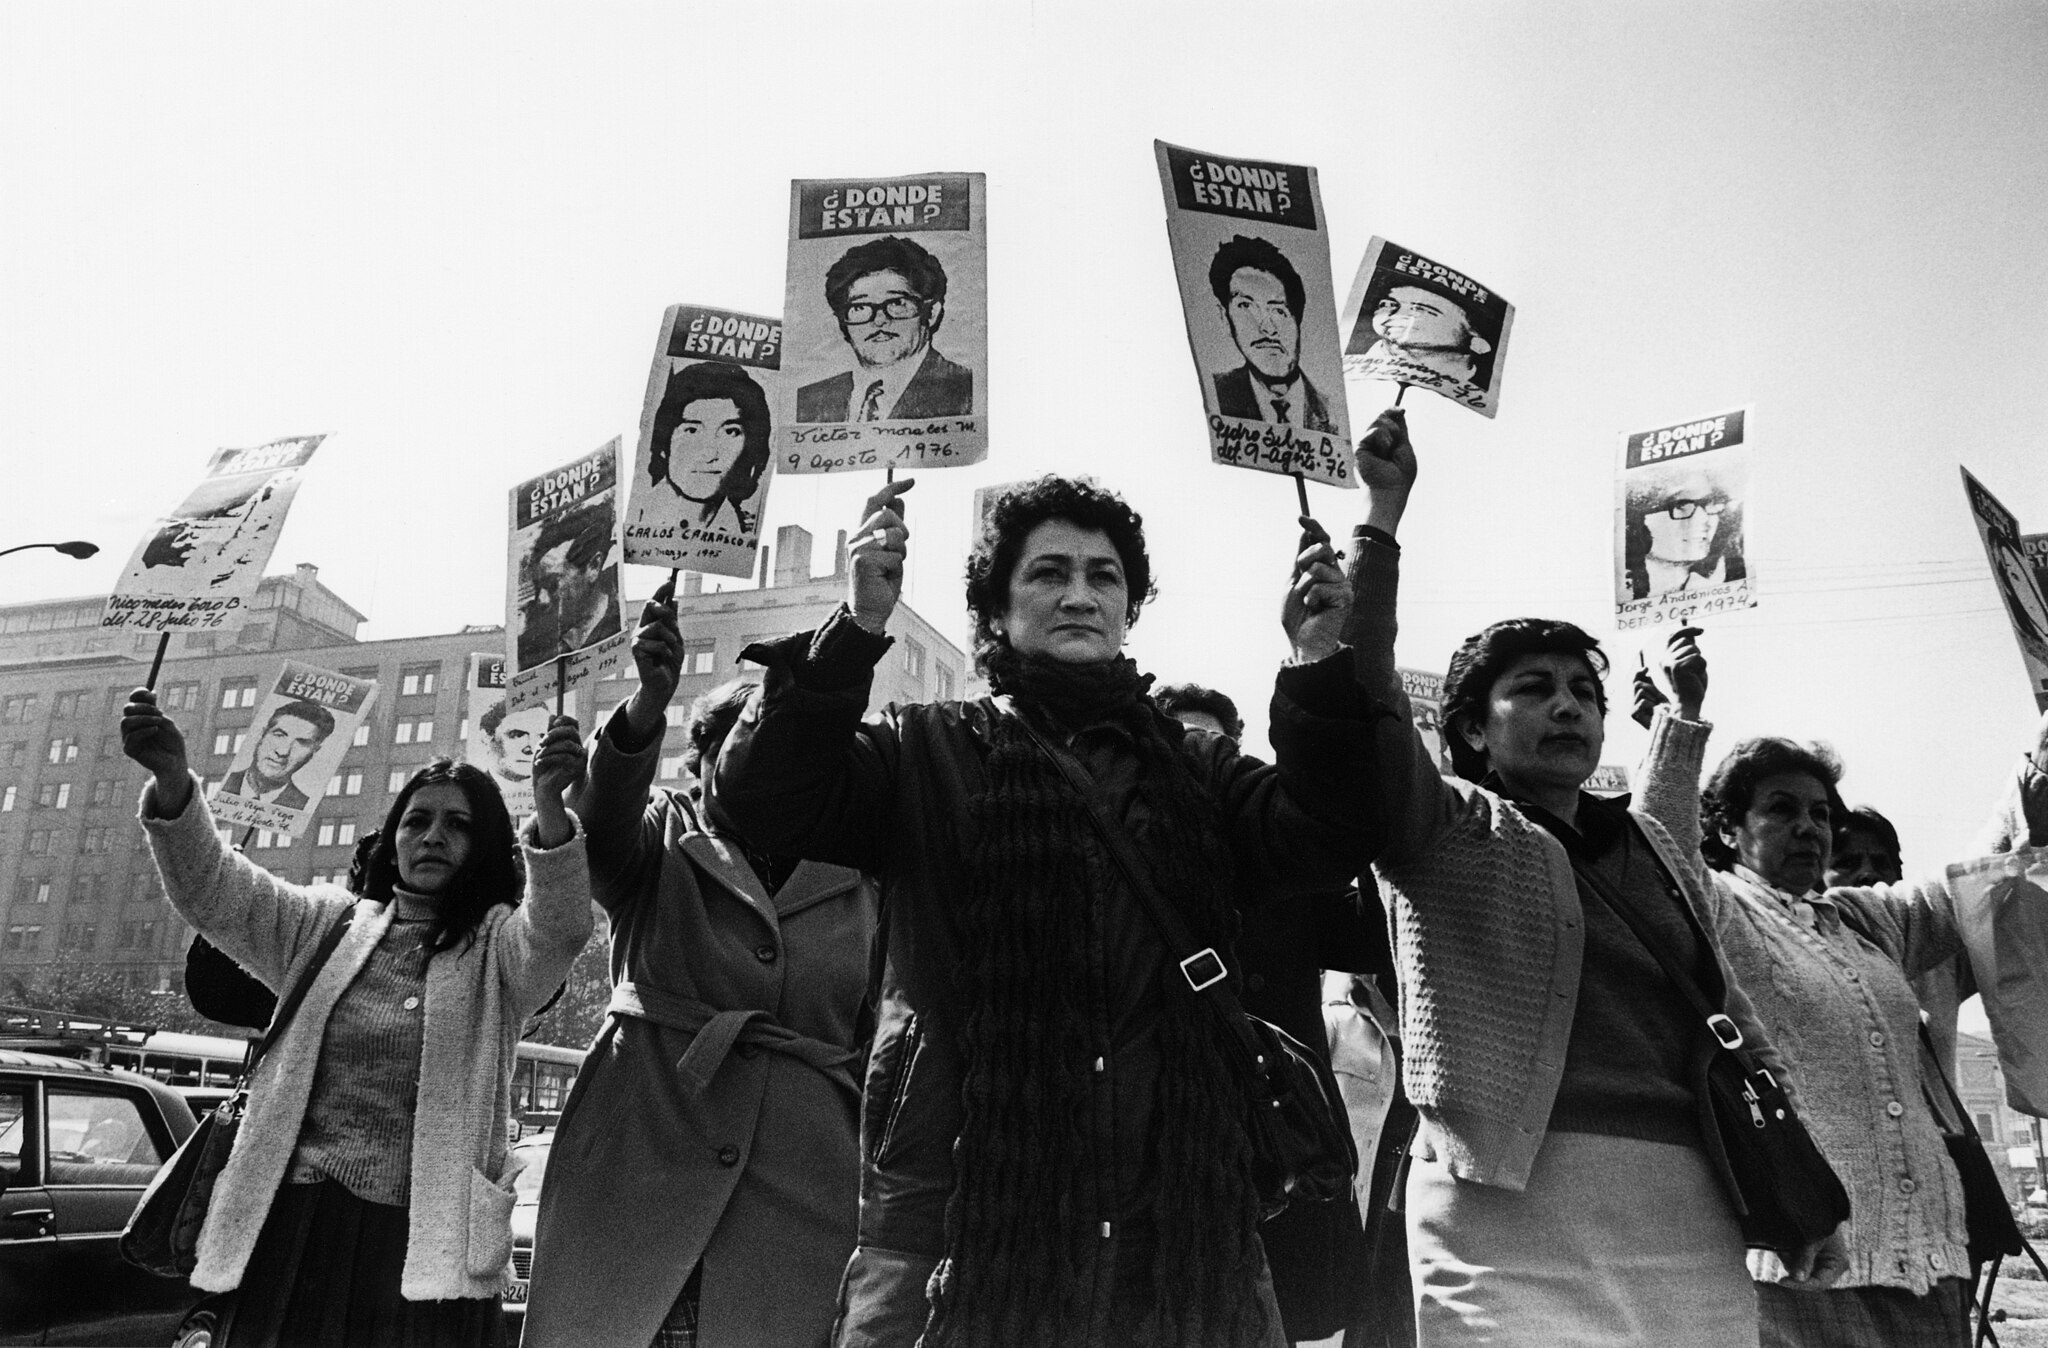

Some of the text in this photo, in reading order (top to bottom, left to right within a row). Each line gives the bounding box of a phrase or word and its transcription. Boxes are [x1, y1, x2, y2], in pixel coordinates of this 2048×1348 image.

[788, 454, 800, 469] 9
[1616, 600, 1653, 614] Jorge
[202, 612, 227, 628] 76
[1654, 611, 1664, 623] 3
